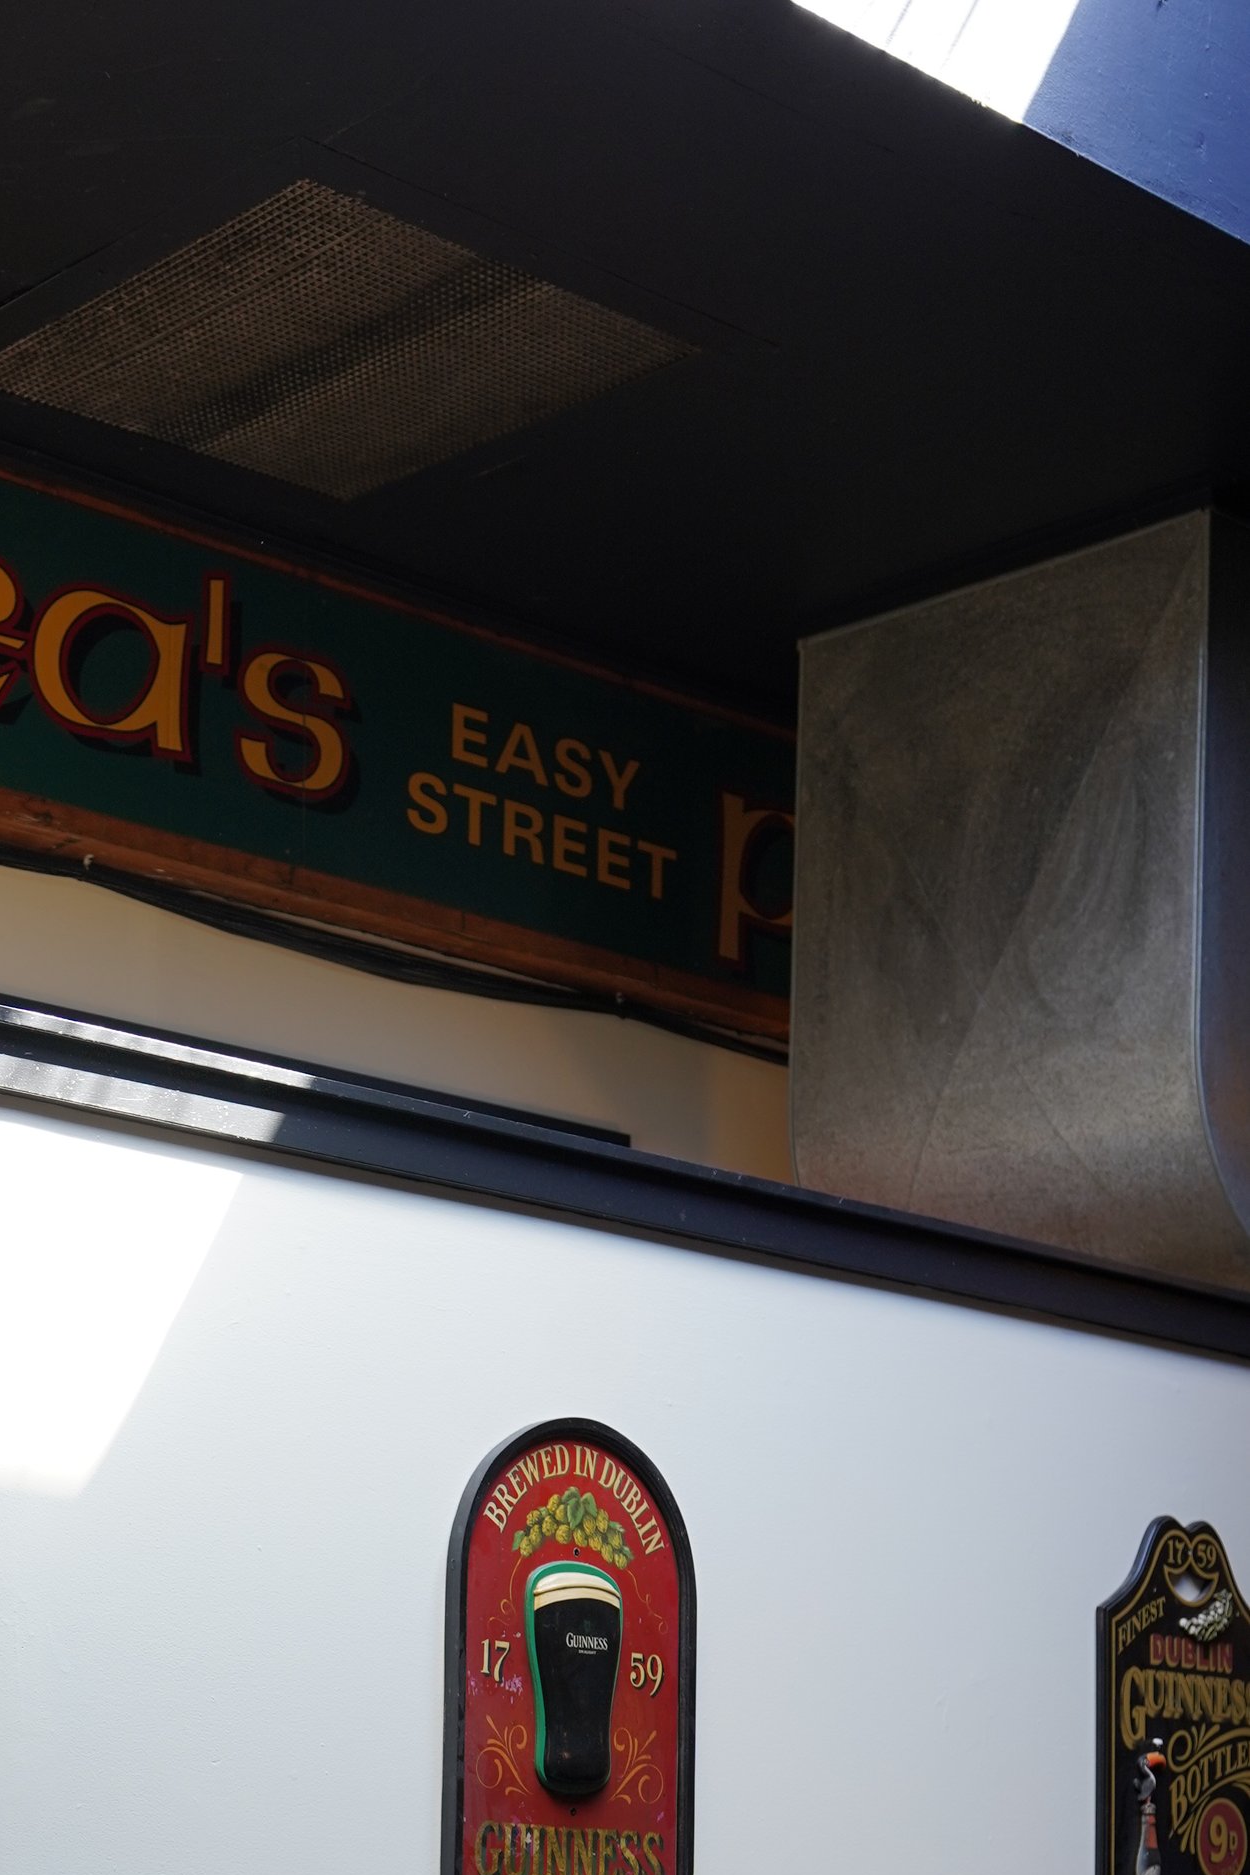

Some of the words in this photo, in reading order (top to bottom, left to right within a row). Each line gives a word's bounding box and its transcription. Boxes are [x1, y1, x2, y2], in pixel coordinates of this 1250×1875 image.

[451, 702, 640, 810] EASY
[405, 771, 678, 899] STREET
[483, 1443, 571, 1534] BREWED
[573, 1444, 599, 1481] IN
[598, 1456, 665, 1556] DUBLIN
[1167, 1539, 1186, 1565] 17
[1197, 1543, 1217, 1570] 59
[565, 1632, 609, 1651] GUINNESS
[1118, 1596, 1166, 1654] FINEST
[1150, 1633, 1233, 1674] DUBLIN
[479, 1638, 511, 1683] 17
[629, 1652, 665, 1697] 59
[1121, 1666, 1250, 1750] GUINNES
[1169, 1740, 1250, 1831] BOTTLE
